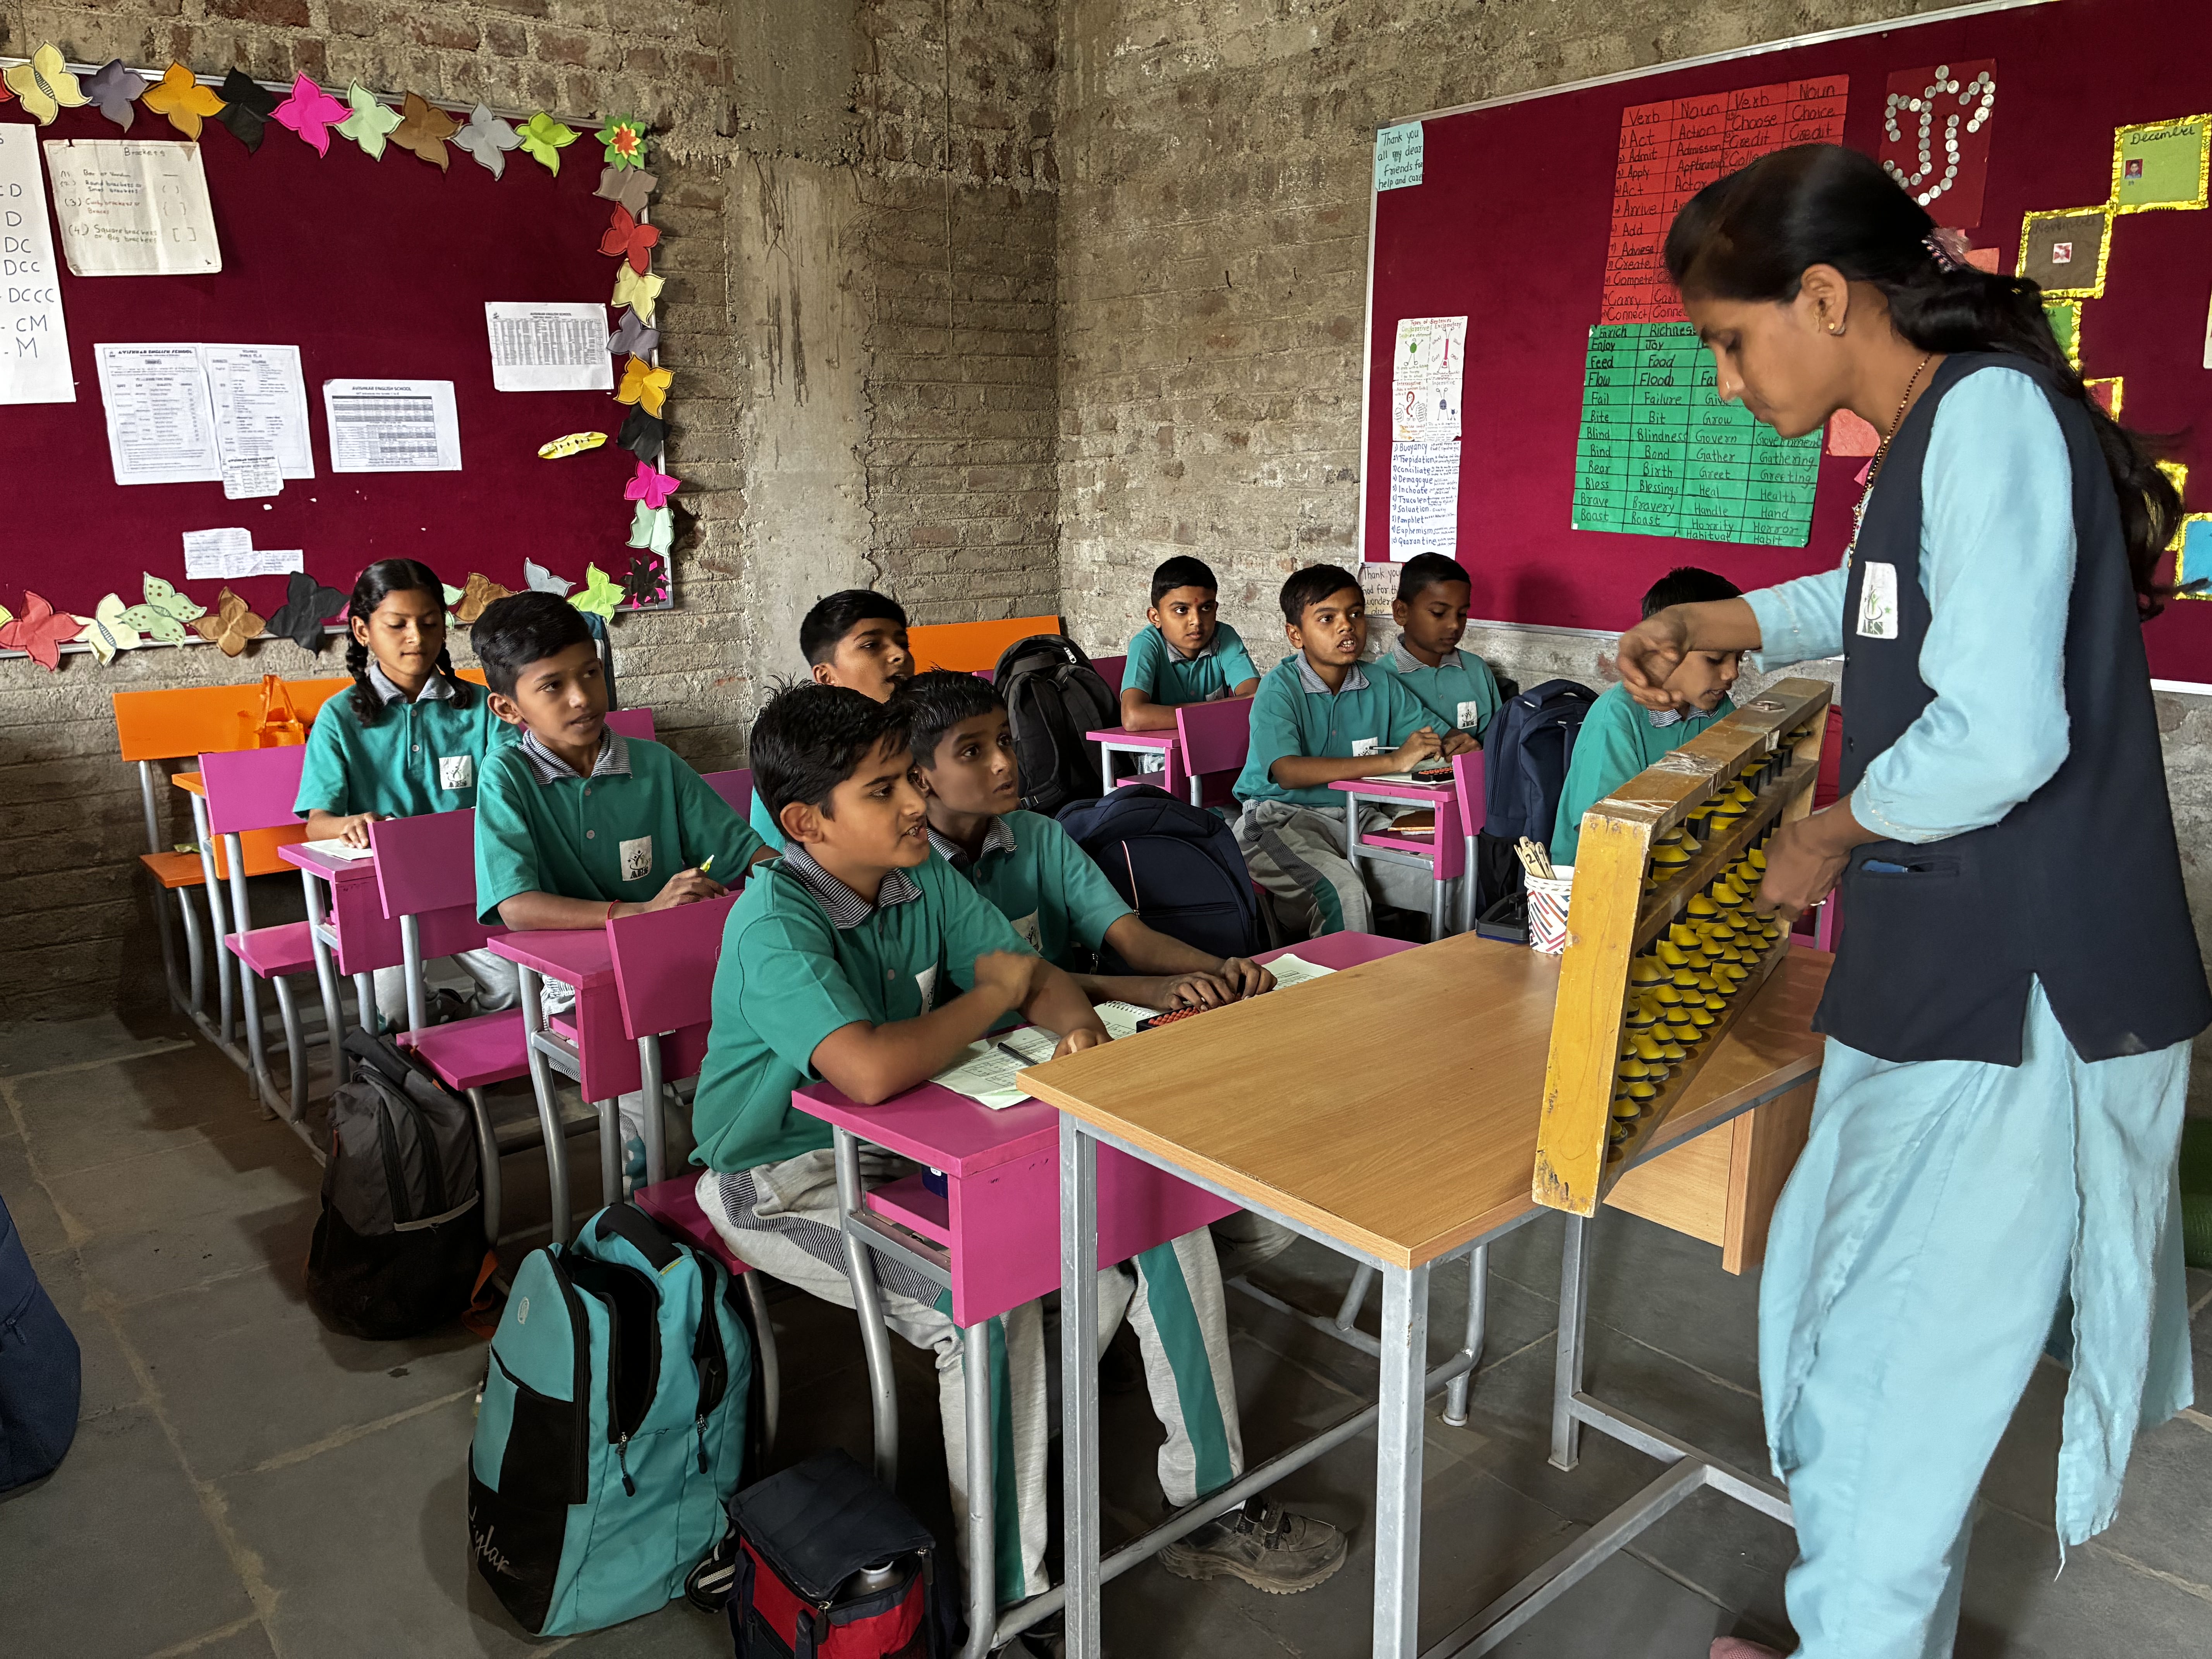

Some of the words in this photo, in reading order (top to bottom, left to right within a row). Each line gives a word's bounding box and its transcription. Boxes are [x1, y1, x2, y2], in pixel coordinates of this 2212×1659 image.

[1629, 108, 1659, 126] Verb
[1681, 101, 1719, 119] Noun
[1735, 89, 1769, 110] Verb
[1800, 83, 1835, 99] Noun
[1630, 129, 1655, 148] Act
[1679, 124, 1716, 139] Action
[1732, 114, 1777, 131] Choose
[1792, 105, 1834, 121] Choice
[1381, 131, 1402, 146] Thank
[1407, 130, 1419, 144] you
[1629, 147, 1657, 162] Admit
[1676, 141, 1721, 156] Admission
[1729, 130, 1770, 148] Credit
[1790, 122, 1832, 141] Credit
[2130, 126, 2196, 145] December
[1377, 150, 1388, 161] all
[1392, 150, 1402, 163] my
[1405, 145, 1422, 156] dear
[1628, 164, 1650, 180] Apply
[1379, 178, 1393, 190] help
[1395, 175, 1406, 185] and
[1622, 181, 1643, 196] Act
[1675, 175, 1707, 192] Actor
[65, 198, 82, 206] (3)
[1623, 199, 1657, 217] Arrive
[6, 211, 22, 227] D
[69, 224, 89, 236] (4)
[1623, 223, 1643, 237] Add
[5, 237, 31, 253] DC
[4, 259, 40, 275] DCC
[1615, 257, 1650, 270] Create
[1614, 272, 1652, 289] Compete
[9, 288, 54, 303] DCCC
[1608, 291, 1641, 309] Carry
[1607, 307, 1647, 321] Connect
[16, 314, 47, 331] CM
[1599, 326, 1626, 338] Enrich
[16, 337, 38, 358] M
[1592, 338, 1615, 352] Enjoy
[1646, 340, 1664, 351] Joy
[1591, 356, 1614, 368] Feed
[1649, 354, 1676, 368] Food
[1589, 372, 1610, 386] Flow
[1640, 368, 1674, 387] Flood
[1592, 392, 1609, 405] Fail
[1645, 392, 1682, 405] Failure
[1591, 410, 1609, 422] Bite
[1649, 410, 1666, 424] Bit
[1703, 411, 1733, 425] Grow
[1587, 426, 1610, 440] Blind
[1637, 428, 1687, 442] Blindness
[1695, 429, 1737, 443] Govern
[1400, 443, 1427, 454] Buoyancy
[1398, 455, 1434, 467] Trepidation
[1590, 444, 1611, 457] Bind
[1697, 448, 1735, 462] Gather
[1760, 452, 1815, 472] Gathering
[1399, 475, 1433, 488] Demagogue
[1589, 460, 1611, 473] Bear
[1644, 461, 1672, 477] Birth
[1699, 466, 1731, 479] Greet
[1760, 469, 1811, 489] Greeting
[1399, 485, 1428, 494] Inchoate
[1585, 477, 1609, 489] Bless
[1640, 479, 1679, 500] Blessings
[1700, 484, 1720, 498] Heal
[1761, 488, 1796, 504] Health
[1398, 496, 1431, 504] Truculent
[1581, 492, 1609, 507] Brave
[1632, 496, 1674, 517] Bravery
[1695, 502, 1728, 516] Handle
[1761, 506, 1789, 519] Hand
[1581, 508, 1609, 521] Boast
[1631, 511, 1661, 526] Boast
[1692, 518, 1734, 536] Horrify
[1753, 521, 1799, 534] Horror
[1362, 567, 1385, 580] Thank
[1377, 584, 1389, 594] for
[1862, 619, 1883, 635] AES
[1525, 854, 1536, 864] 2
